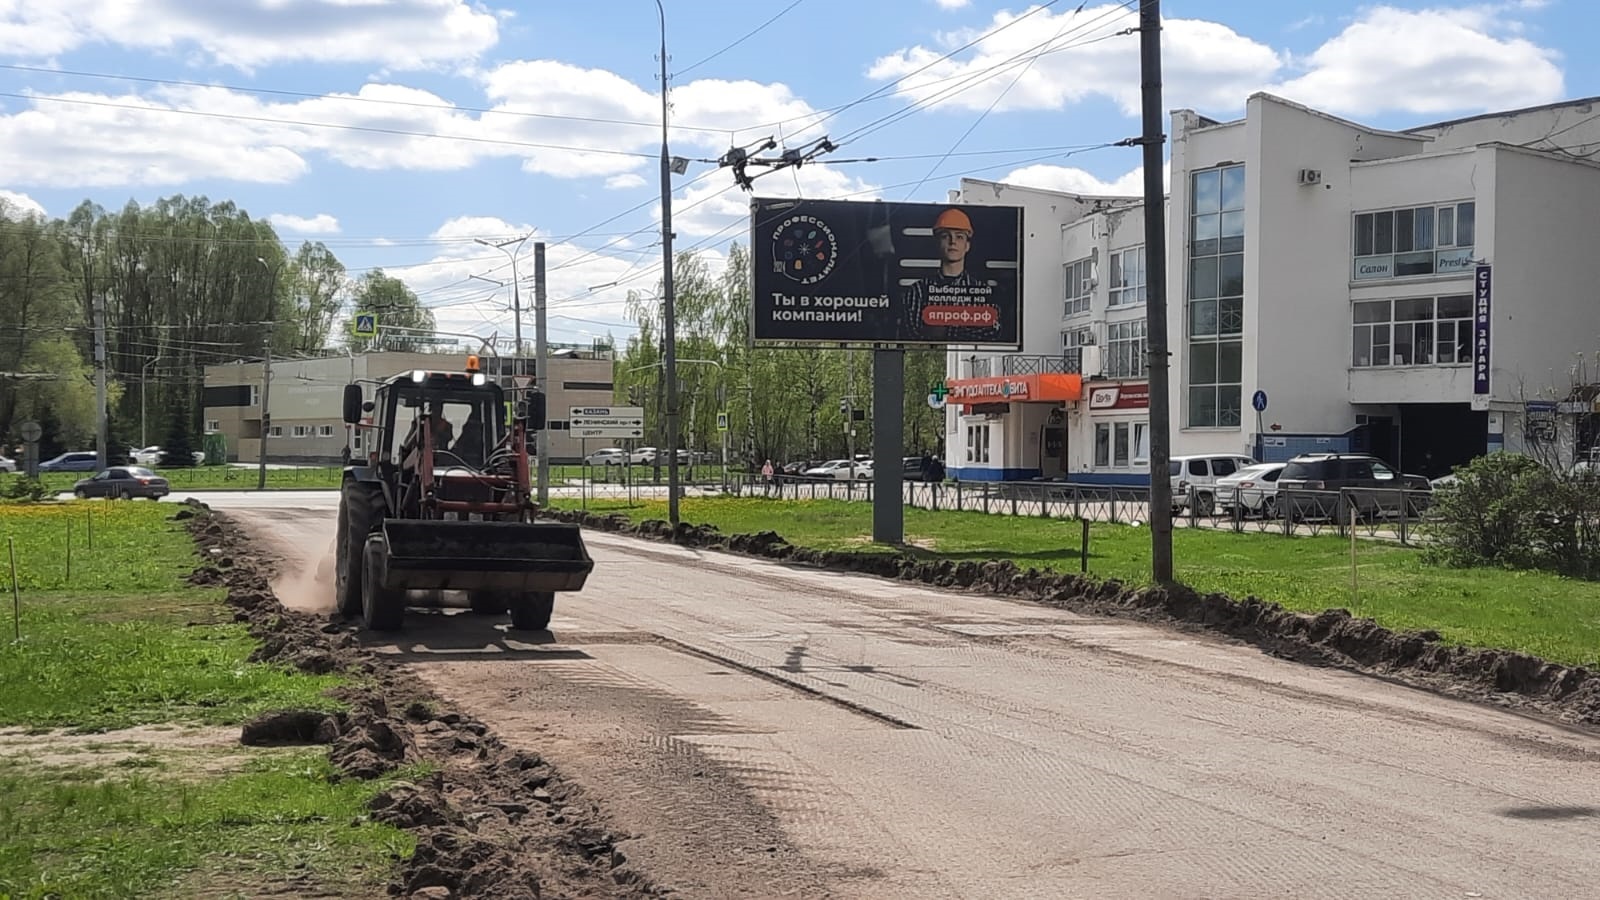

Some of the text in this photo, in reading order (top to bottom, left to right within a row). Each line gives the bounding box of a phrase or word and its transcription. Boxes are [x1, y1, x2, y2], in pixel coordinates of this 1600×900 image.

[772, 215, 838, 284] ПРОФЕССИОНАЛИТЕТ
[1359, 263, 1388, 274] Салон
[928, 285, 992, 295] Выбери свой
[772, 292, 889, 310] Ты в хорошей
[928, 295, 971, 303] колледж
[772, 309, 862, 322] компании!
[928, 310, 992, 323] япроф.рф
[1477, 271, 1488, 381] СТУДИЯ ЗАГАРА
[1009, 381, 1028, 395] ВИТА
